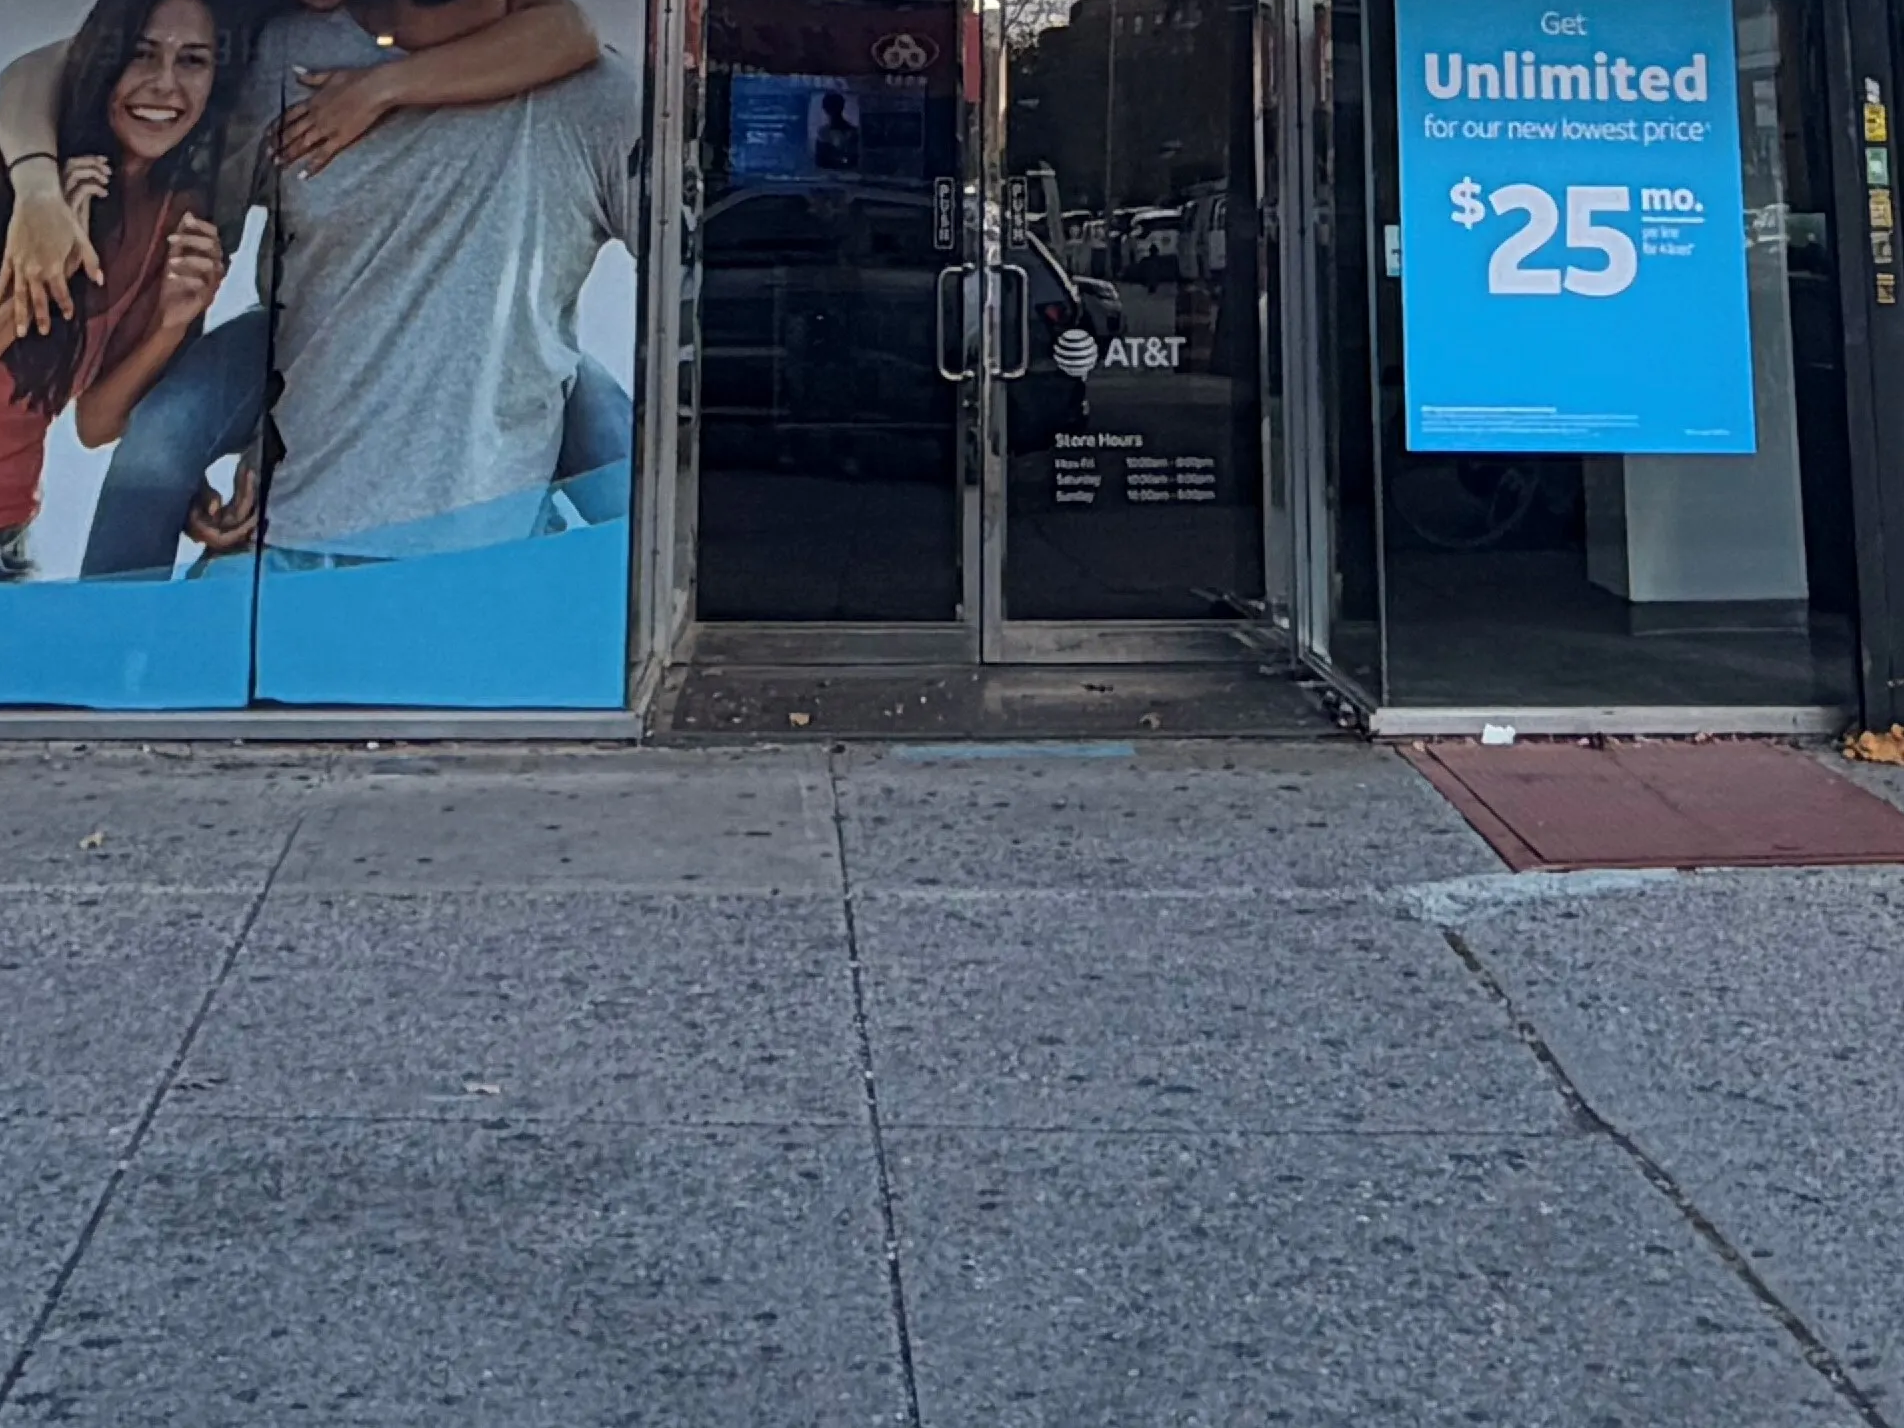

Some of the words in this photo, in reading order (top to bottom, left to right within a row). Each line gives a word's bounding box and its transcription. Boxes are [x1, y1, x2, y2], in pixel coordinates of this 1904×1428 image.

[1540, 11, 1588, 36] Get
[1425, 51, 1709, 102] Unlimited
[1424, 114, 1457, 139] for
[1463, 119, 1502, 139] our
[1508, 120, 1557, 140] new
[1562, 117, 1638, 142] lowest
[1450, 176, 1638, 297] $25
[1640, 188, 1704, 212] mo.
[1104, 336, 1187, 368] AT&T
[1054, 432, 1096, 448] Store
[1098, 432, 1144, 448] Hours
